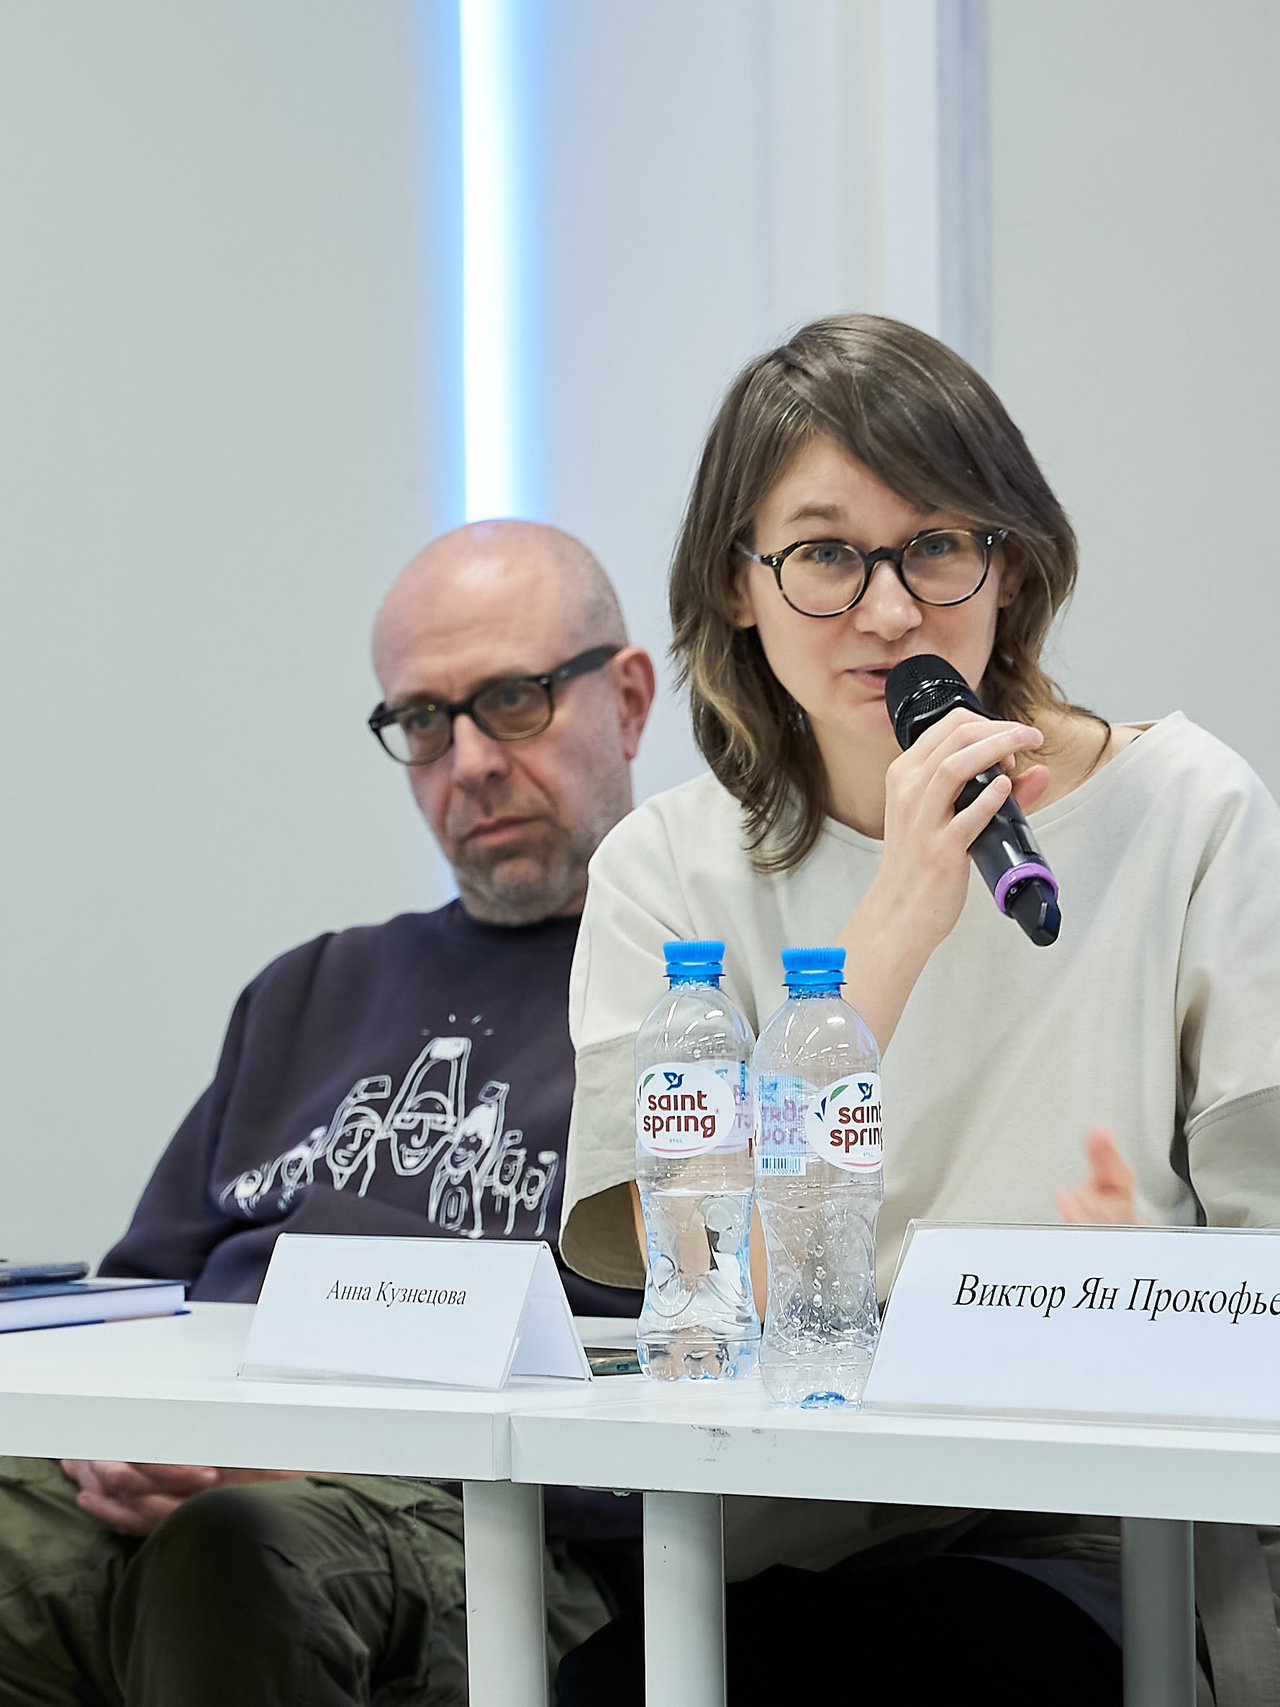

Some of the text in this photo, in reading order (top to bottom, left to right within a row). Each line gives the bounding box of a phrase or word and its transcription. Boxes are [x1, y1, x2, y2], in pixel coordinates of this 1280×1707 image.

[648, 1090, 708, 1111] saint
[643, 1114, 716, 1139] spring
[326, 1279, 467, 1309] Анна Кузнецова
[953, 1273, 1066, 1319] Виктор
[1072, 1277, 1119, 1310] Ян
